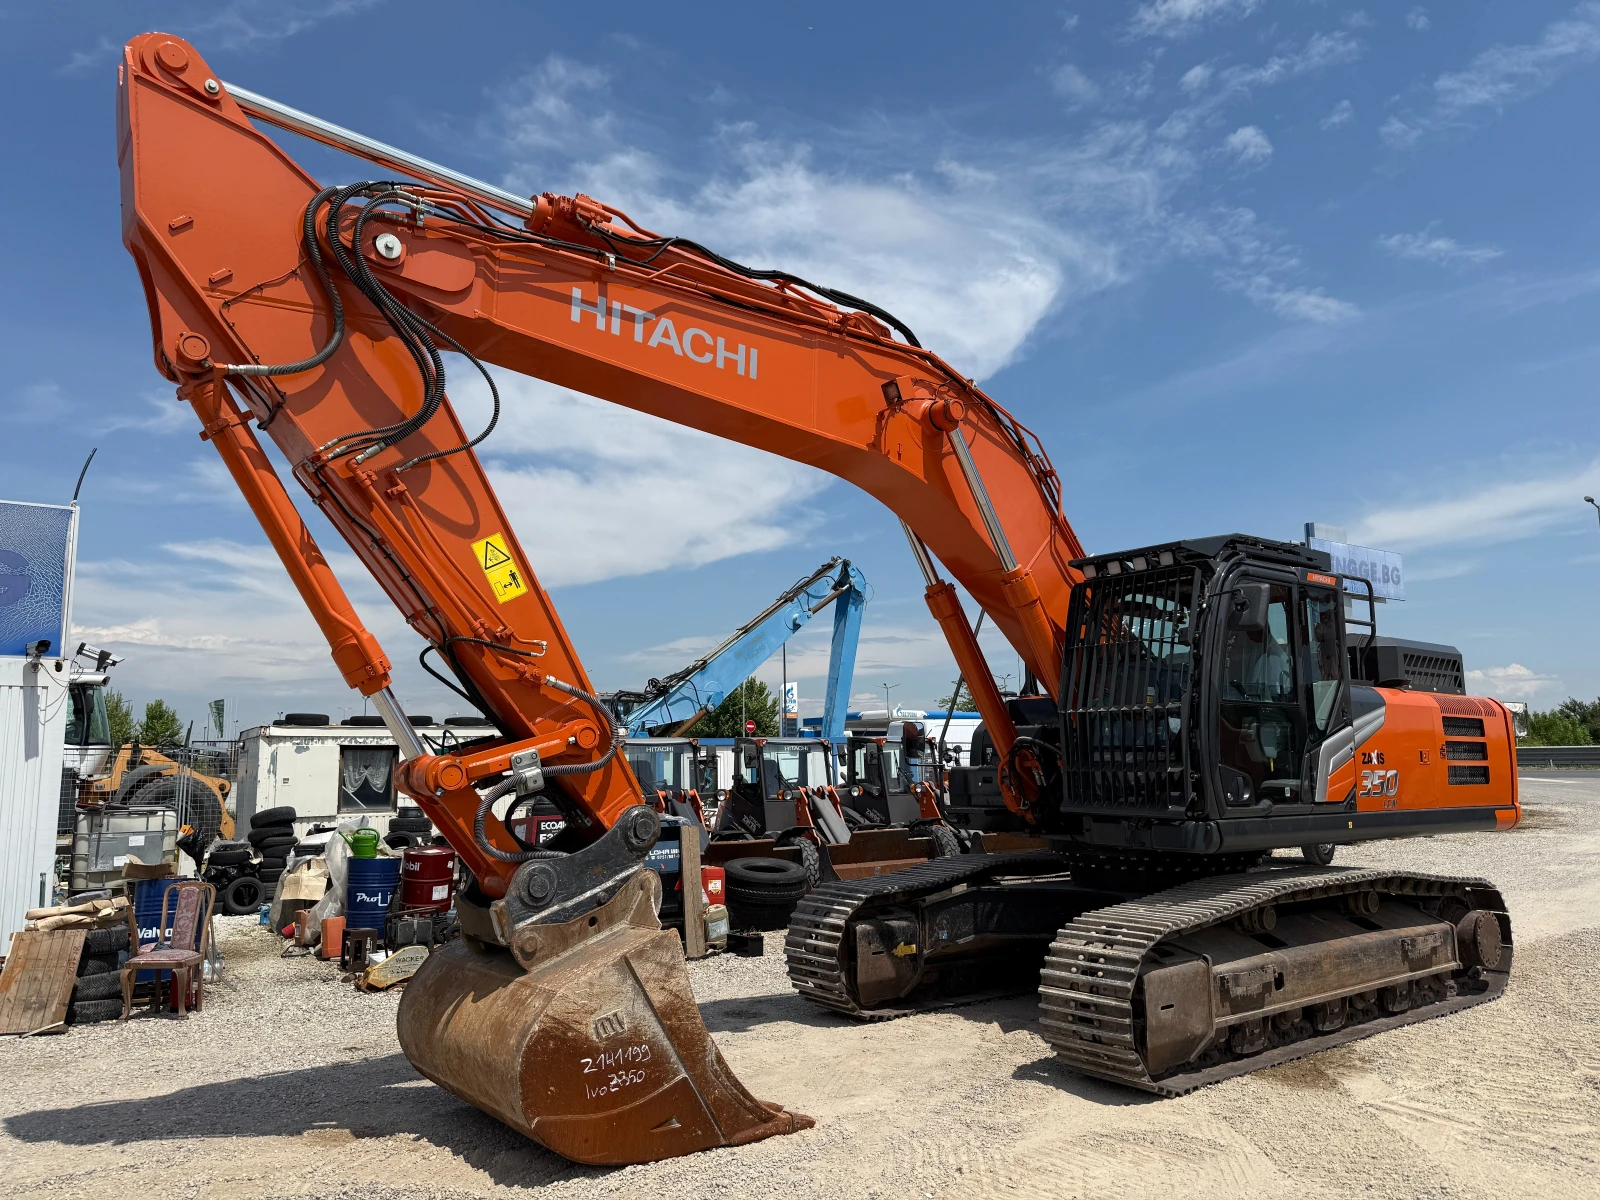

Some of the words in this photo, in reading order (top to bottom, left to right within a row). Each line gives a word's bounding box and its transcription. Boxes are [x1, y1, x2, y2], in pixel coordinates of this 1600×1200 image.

[571, 287, 758, 379] HITACHI
[1361, 750, 1385, 765] ZAXIS
[1359, 770, 1398, 797] 350
[395, 955, 425, 963] WACKER
[580, 1044, 652, 1074] 2141199
